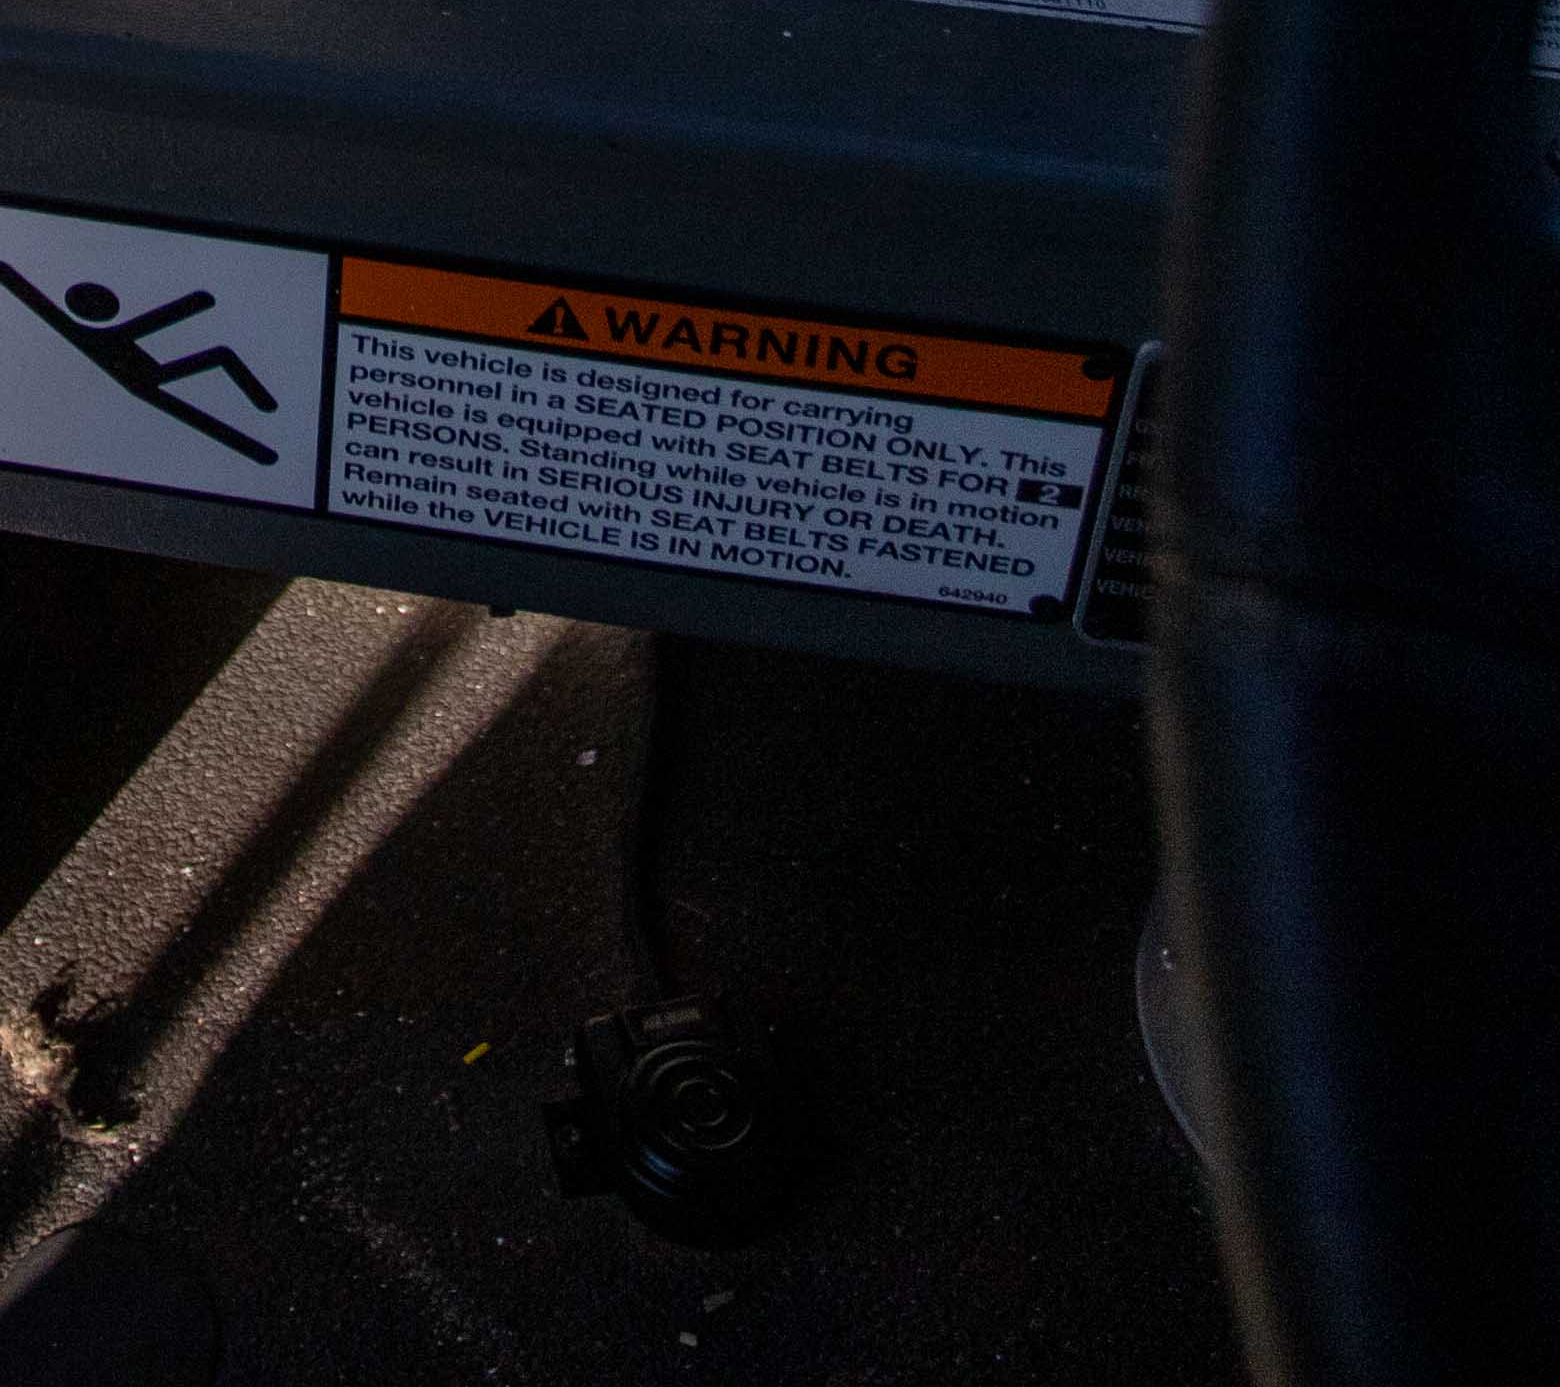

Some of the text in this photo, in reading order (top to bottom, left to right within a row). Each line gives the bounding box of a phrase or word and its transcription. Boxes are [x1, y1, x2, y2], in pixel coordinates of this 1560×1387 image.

[351, 333, 913, 434] This vehicle is designed for carrying
[605, 306, 918, 380] WARNING
[347, 411, 1058, 529] PERSONS. Standing while vehicle is in motion
[348, 390, 1062, 505] vehicle is equipped with SEAT BELTS FOR 2
[350, 364, 1066, 476] personnel in a SEATED POSITION ONLY. This
[342, 490, 851, 578] while the VEHICLE IS IN MOTION.
[344, 462, 1035, 576] Remain seated with SEAT BELTS FASTENED
[345, 441, 1004, 548] can result in SERIOUS INJURY OR DEATH.
